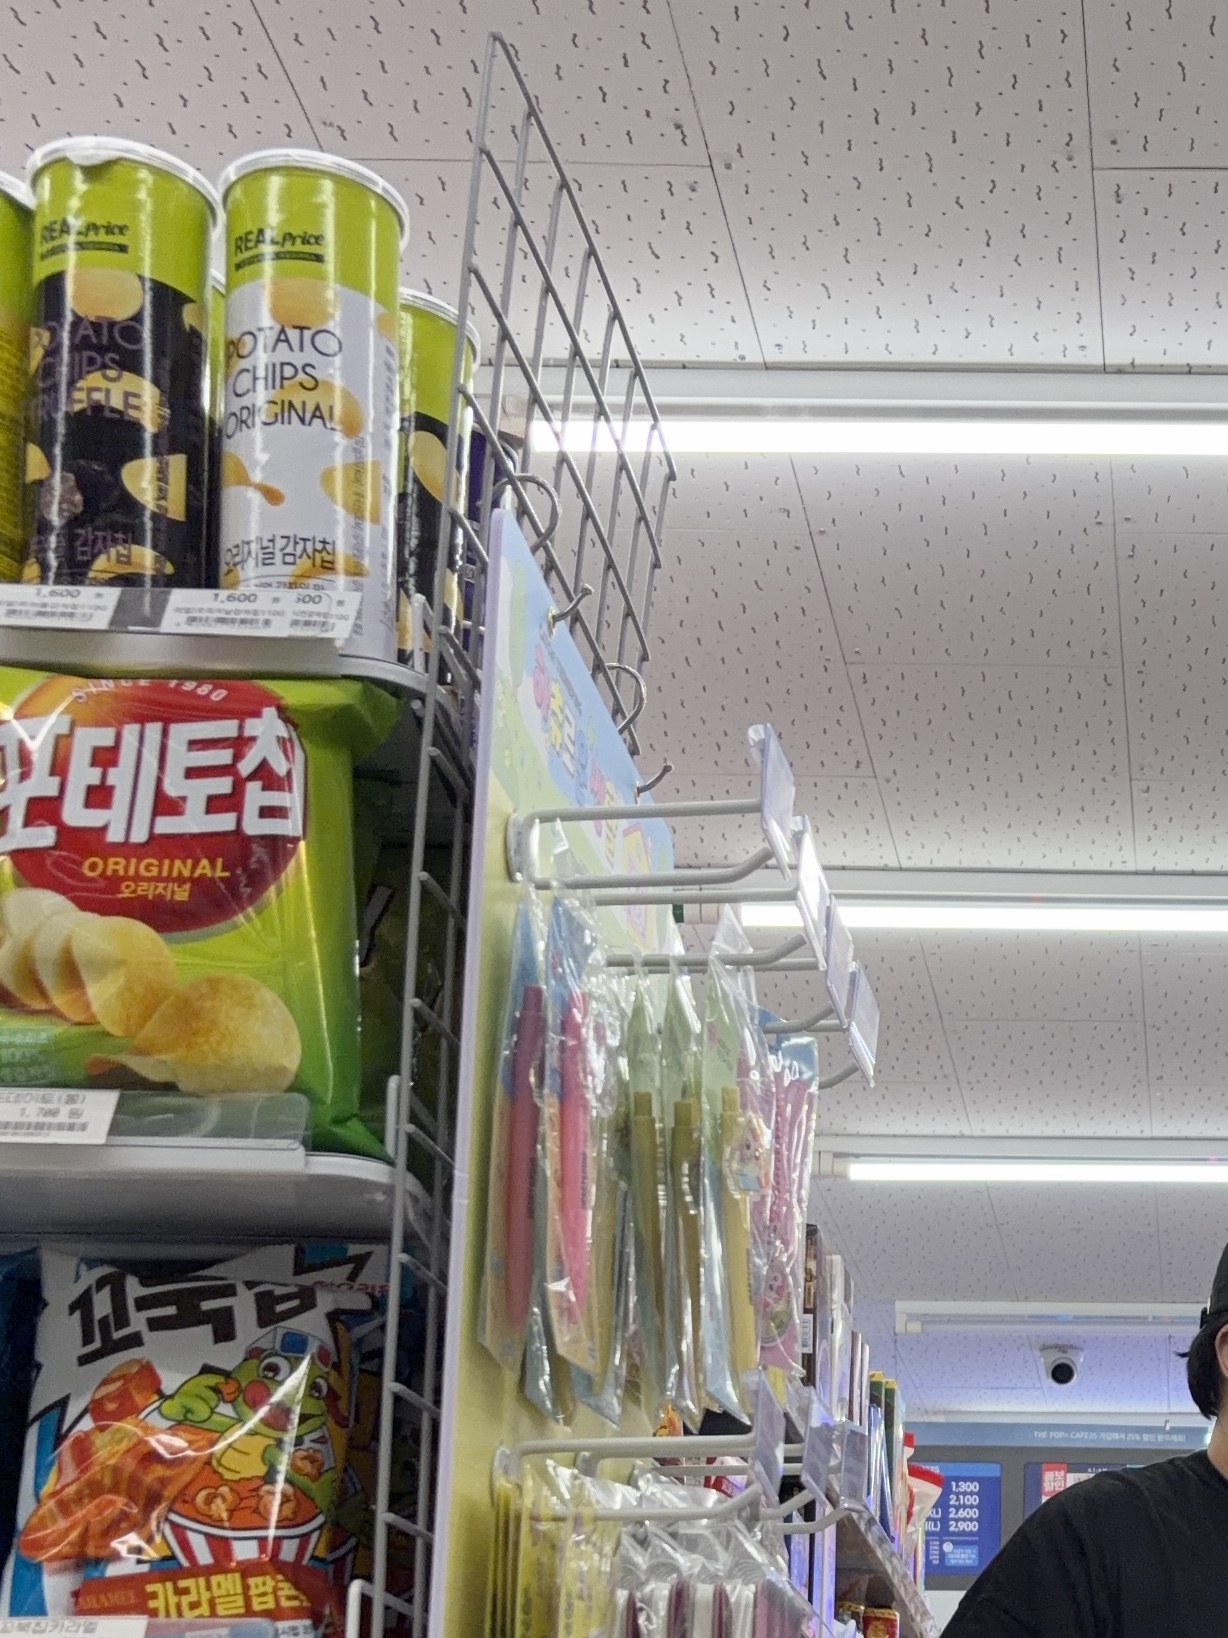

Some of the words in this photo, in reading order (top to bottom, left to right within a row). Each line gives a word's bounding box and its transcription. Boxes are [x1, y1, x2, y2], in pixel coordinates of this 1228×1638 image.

[232, 362, 320, 399] CHIPS
[280, 534, 336, 571] 감자칩
[83, 856, 232, 879] ORIGINAL
[117, 881, 191, 901] 오리지널
[951, 1481, 980, 1493] 1,300
[949, 1494, 980, 1506] 2,100
[948, 1508, 980, 1519] 2,600
[948, 1521, 979, 1533] 2,900
[145, 1572, 246, 1618] 카라멜
